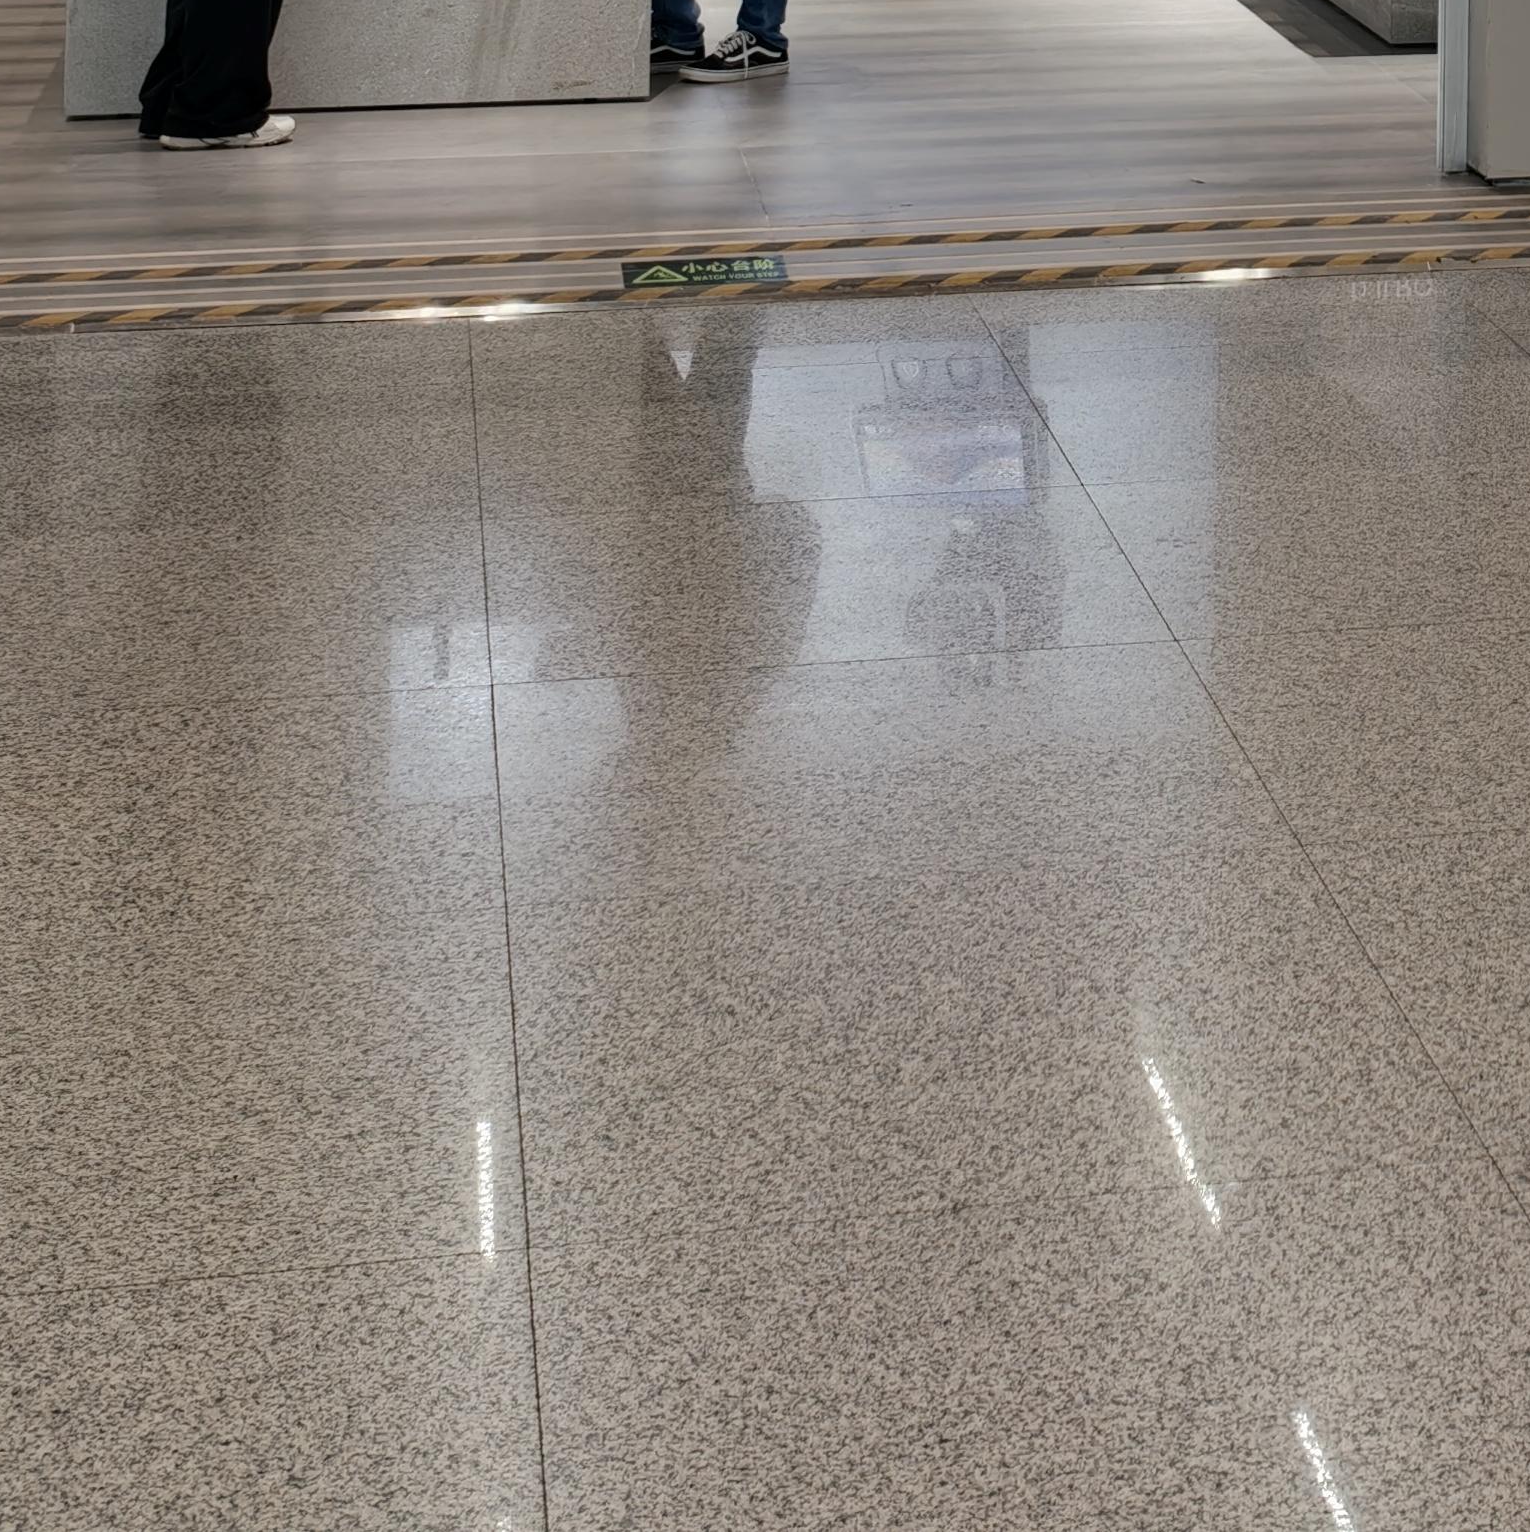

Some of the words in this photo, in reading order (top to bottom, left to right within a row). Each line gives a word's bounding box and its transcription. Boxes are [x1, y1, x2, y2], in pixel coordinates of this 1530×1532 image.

[681, 258, 775, 274] 小心台阶
[692, 274, 727, 282] WATCH
[728, 272, 755, 280] YOUR
